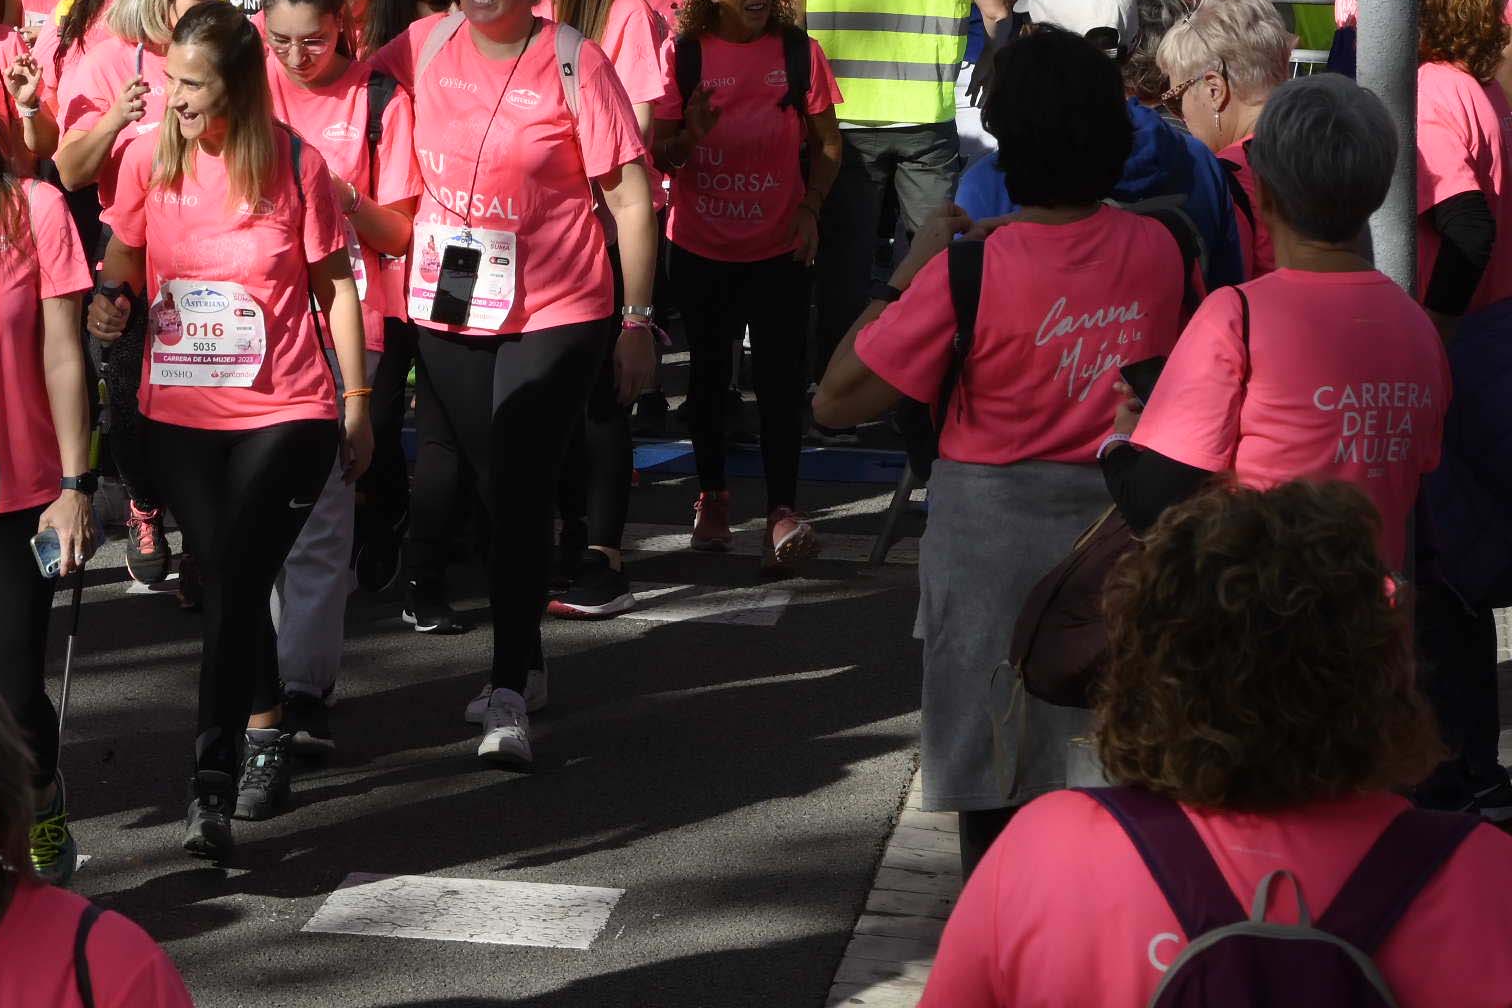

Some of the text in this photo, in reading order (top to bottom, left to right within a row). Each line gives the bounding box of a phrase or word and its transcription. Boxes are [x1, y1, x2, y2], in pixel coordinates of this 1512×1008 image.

[703, 77, 736, 89] YSHO
[419, 149, 445, 174] TU
[696, 145, 722, 166] TU
[696, 196, 763, 219] SUMA
[186, 322, 224, 338] 016
[1035, 296, 1144, 346] Carrera
[193, 342, 217, 352] 5035
[163, 355, 191, 363] CARRERA
[1053, 336, 1129, 402] Mujer
[161, 369, 193, 379] OYSHO
[1313, 381, 1432, 411] CARRERA
[1343, 410, 1413, 437] DE LA
[1334, 437, 1410, 464] MUJER
